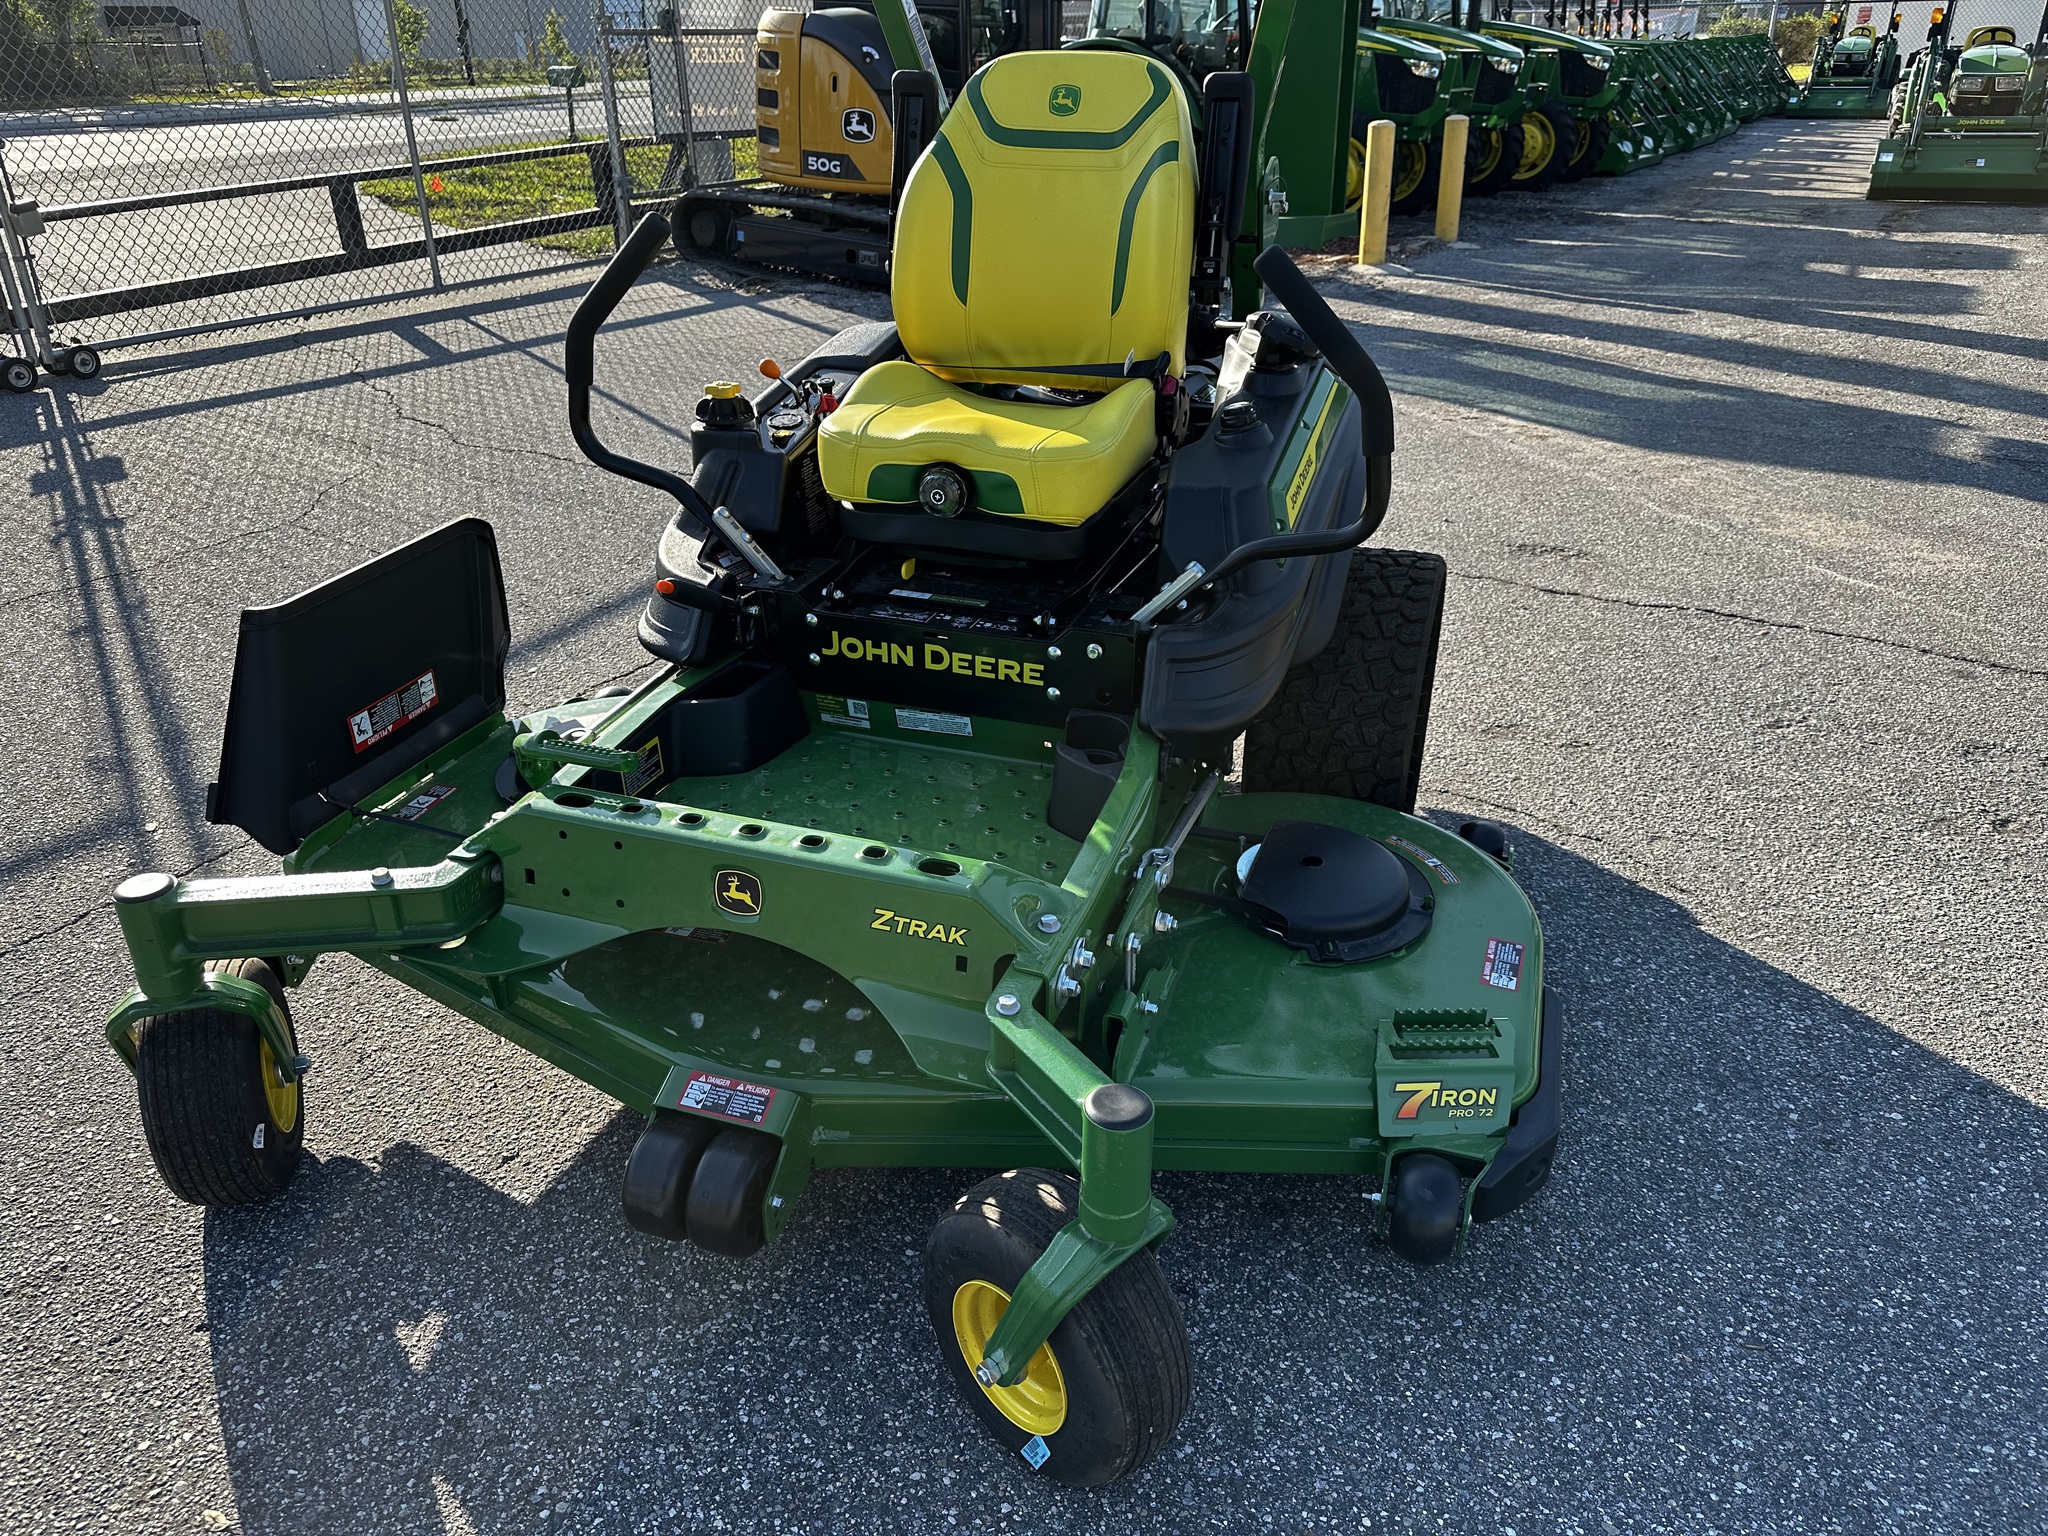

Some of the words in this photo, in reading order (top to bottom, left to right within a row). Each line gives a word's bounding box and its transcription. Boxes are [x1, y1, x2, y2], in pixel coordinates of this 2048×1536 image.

[808, 156, 841, 173] 50G
[1290, 481, 1303, 511] JOHN
[1299, 454, 1314, 487] DEERE
[821, 630, 914, 667] JOHN
[924, 643, 1045, 686] DEERE
[870, 907, 970, 947] ZTRAK
[706, 1075, 731, 1087] DANGER
[744, 1084, 771, 1096] PELIGRO
[1448, 1108, 1475, 1118] PRO
[1478, 1108, 1494, 1117] 72
